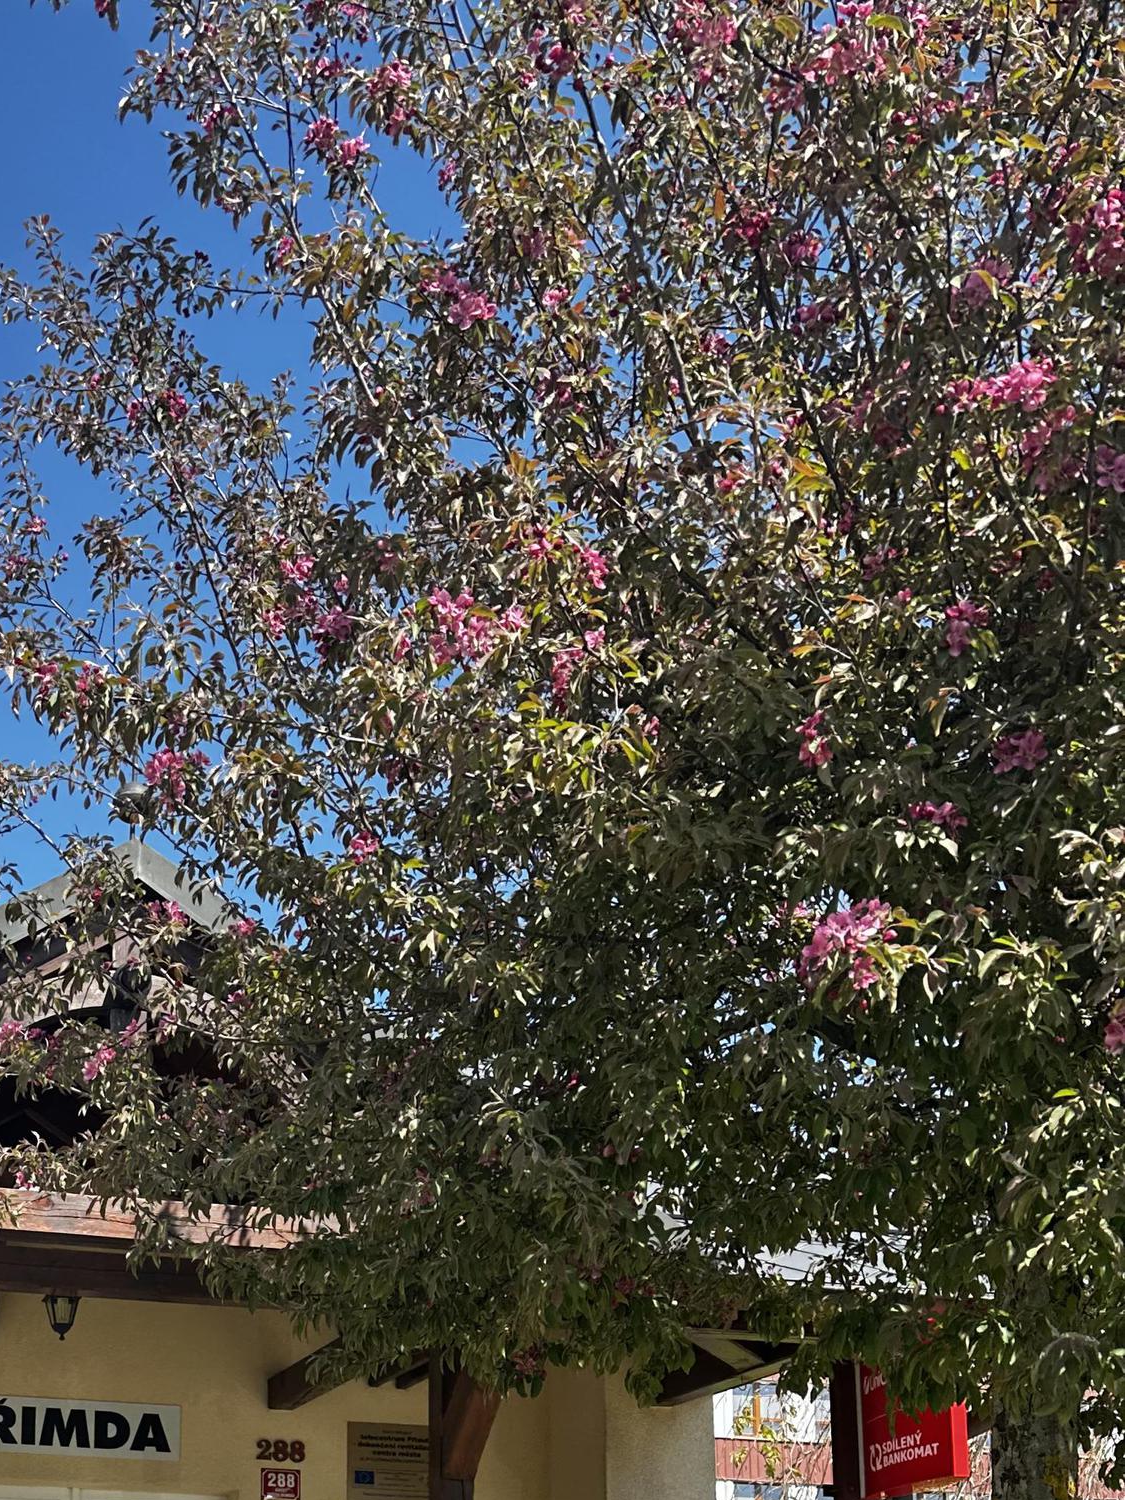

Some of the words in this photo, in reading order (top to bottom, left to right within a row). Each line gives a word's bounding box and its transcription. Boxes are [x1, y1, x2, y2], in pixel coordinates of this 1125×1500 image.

[256, 1439, 306, 1464] 288
[882, 1429, 923, 1455] SDÍLENÝ
[883, 1443, 940, 1467] BANKOMAT
[267, 1472, 296, 1488] 288
